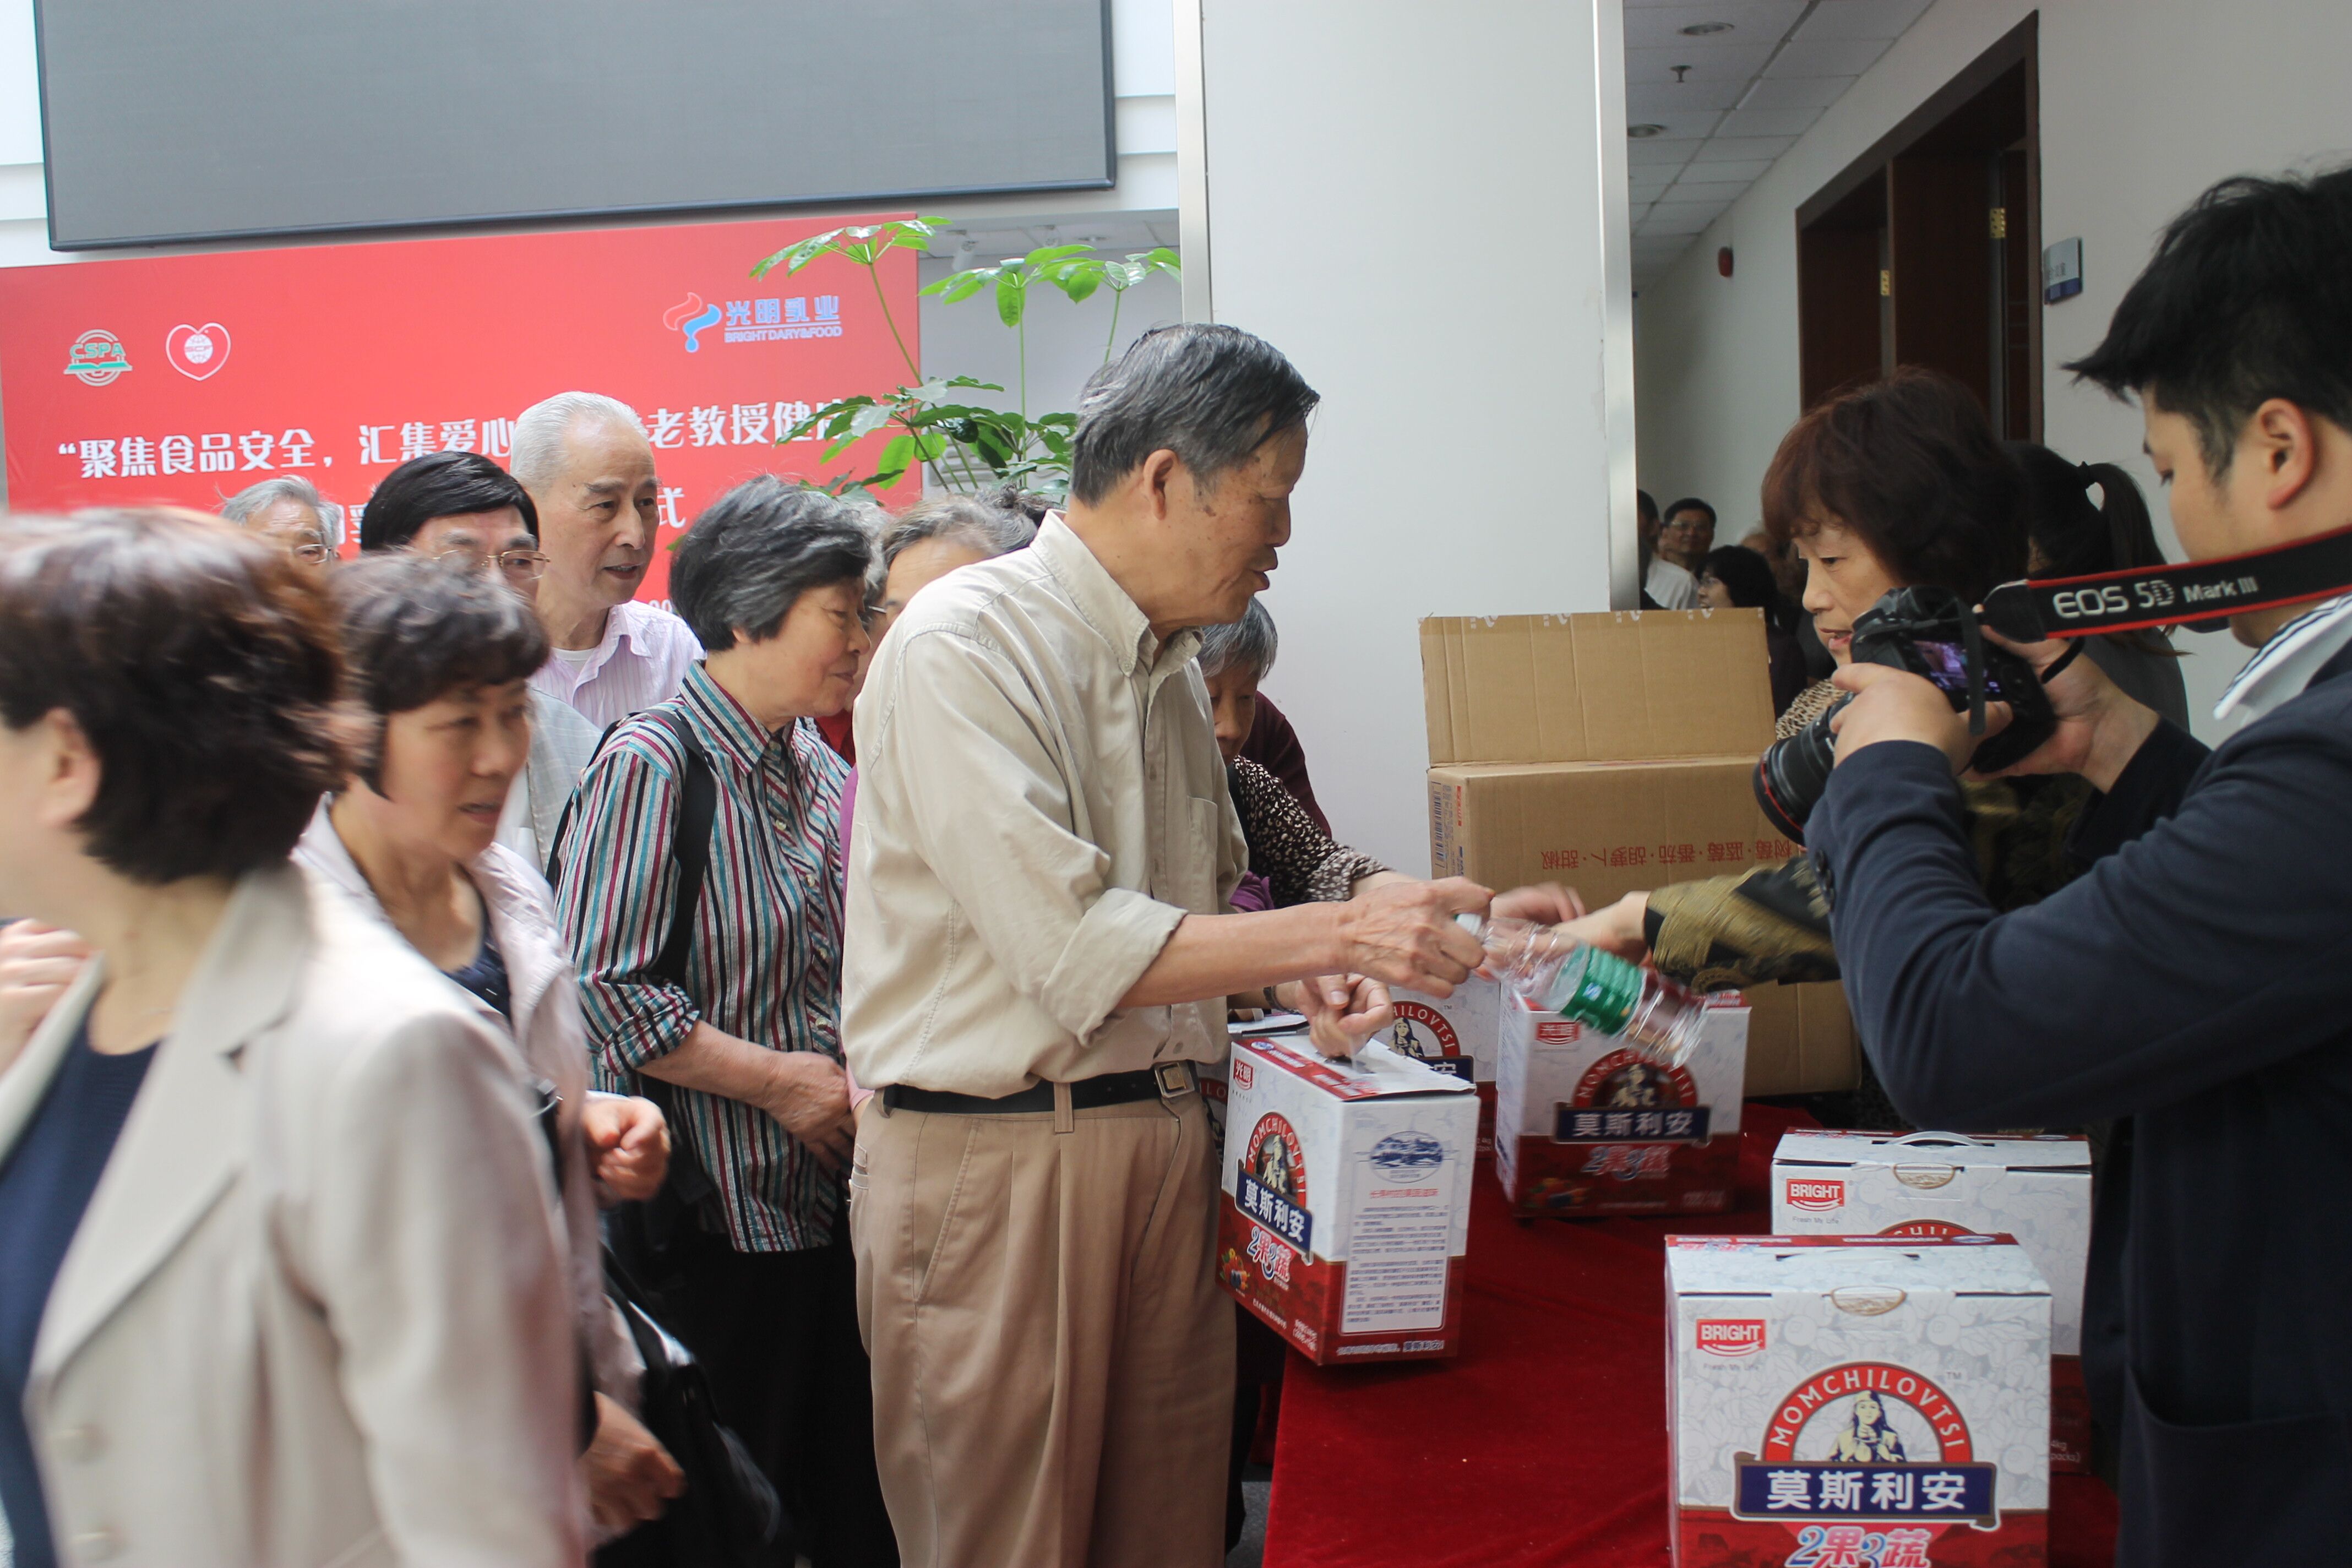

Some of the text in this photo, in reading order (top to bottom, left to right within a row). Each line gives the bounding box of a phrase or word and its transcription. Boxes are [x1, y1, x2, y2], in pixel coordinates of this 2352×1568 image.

[725, 295, 840, 326] 光明乳业
[70, 342, 126, 359] CSPA
[725, 331, 767, 343] BRIGHT
[2052, 586, 2130, 619] EOS
[2133, 579, 2175, 608] 5D
[2182, 580, 2237, 603] Mark
[1235, 1059, 1253, 1083] 光明
[1572, 1112, 1695, 1137] 莫斯利安
[1248, 1118, 1306, 1193] MOMCHILOVTSI
[1790, 1184, 1841, 1199] BRIGHT
[1244, 1178, 1305, 1243] 莫斯利安
[1701, 1325, 1762, 1341] BRIGHT
[1771, 1369, 1966, 1447] MOMCHILOVTSI
[1767, 1470, 1966, 1511] 莫斯利安
